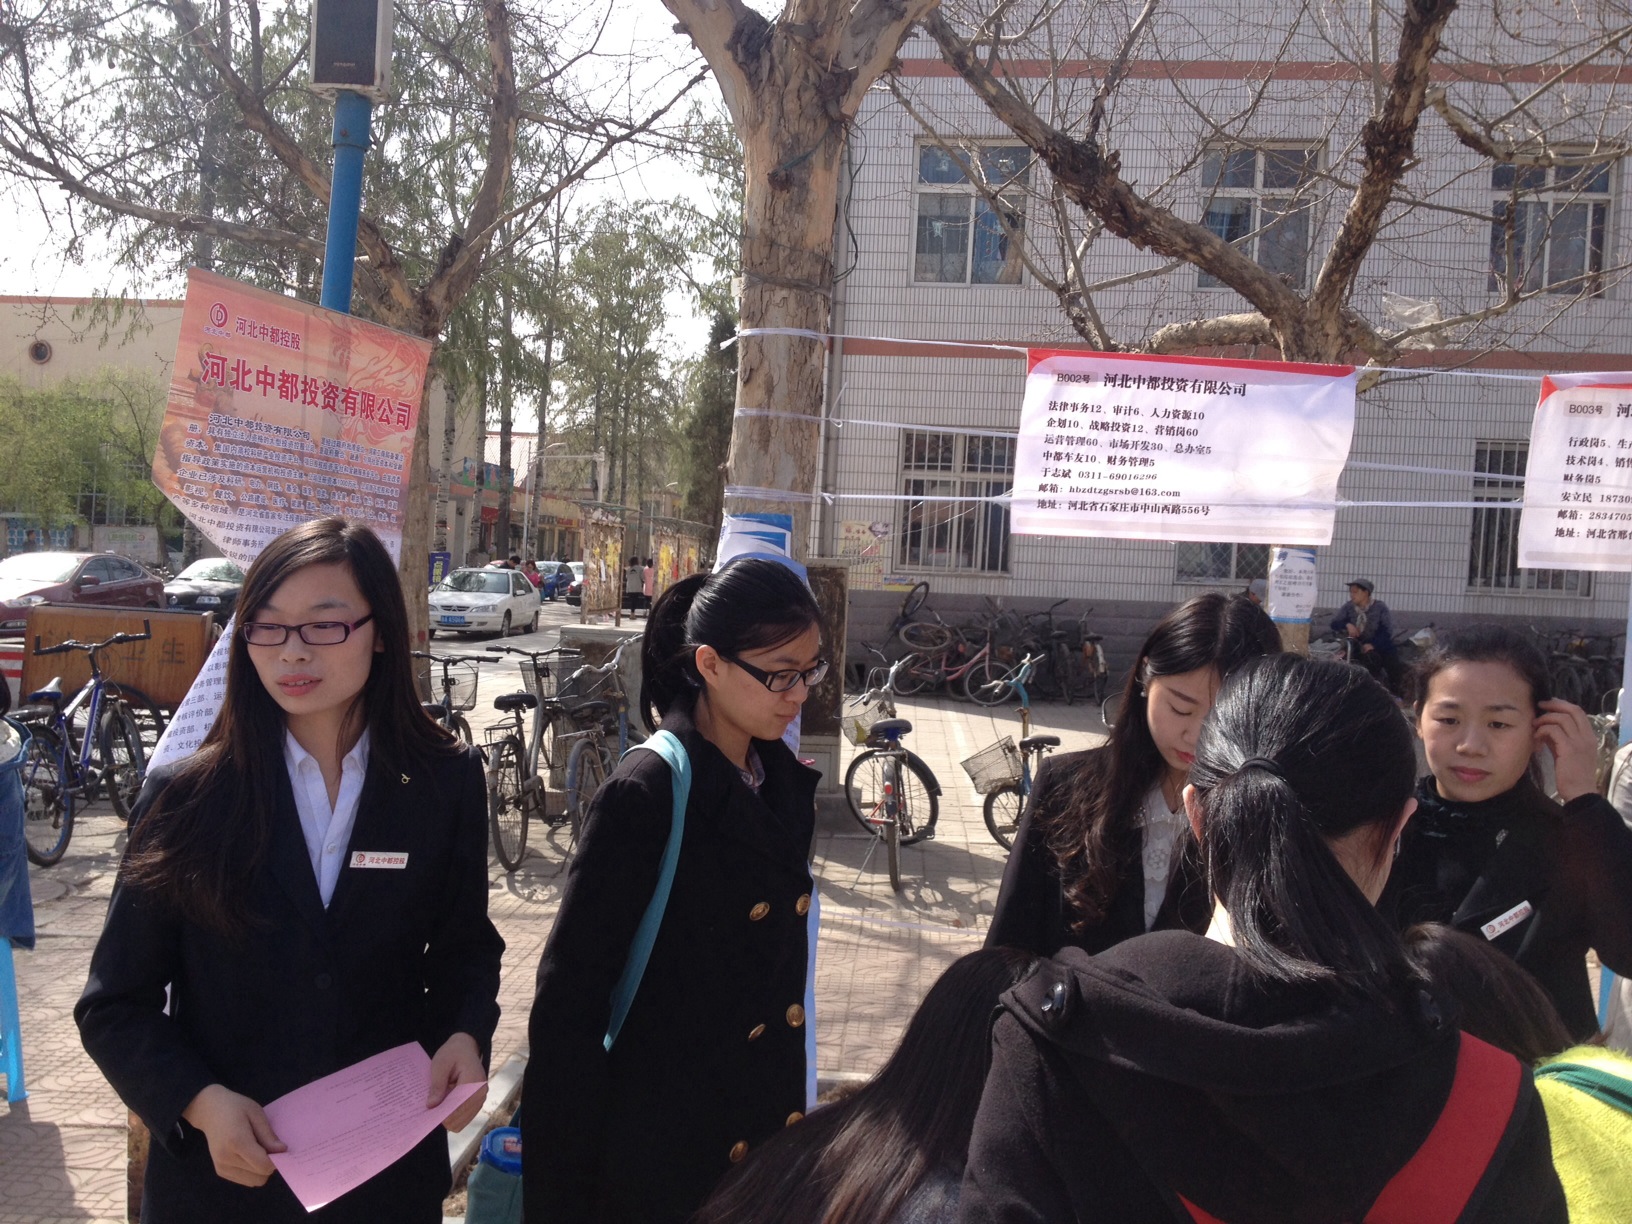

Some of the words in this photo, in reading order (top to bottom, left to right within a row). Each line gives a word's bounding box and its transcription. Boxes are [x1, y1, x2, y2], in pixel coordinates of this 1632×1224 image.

[203, 326, 232, 339] 河北中都
[235, 316, 301, 350] 河北中都控股
[201, 352, 411, 430] 河北中都投资有限公司
[1057, 374, 1091, 384] B002号
[1103, 373, 1247, 397] 河北中都投资有限公司
[1048, 400, 1205, 421] 法律事务12、审计6、人力资源10
[1568, 404, 1604, 415] B003号
[1616, 403, 1632, 418] 河
[1046, 417, 1199, 437] 企划10、战略投资12、营销岗60
[1044, 434, 1212, 455] 运营管理60、市场开发30、总办室5
[1568, 436, 1632, 449] 行政岗5、生
[1043, 450, 1155, 467] 中都车友10、财务管理5
[1041, 467, 1072, 479] 于志斌
[1078, 470, 1158, 480] 0311-69016296
[1563, 474, 1601, 484] 财务岗5
[1561, 492, 1593, 503] 安立民
[1600, 494, 1632, 504] 18730
[1037, 499, 1211, 516] 地址：河北省石家庄市中山西路556号
